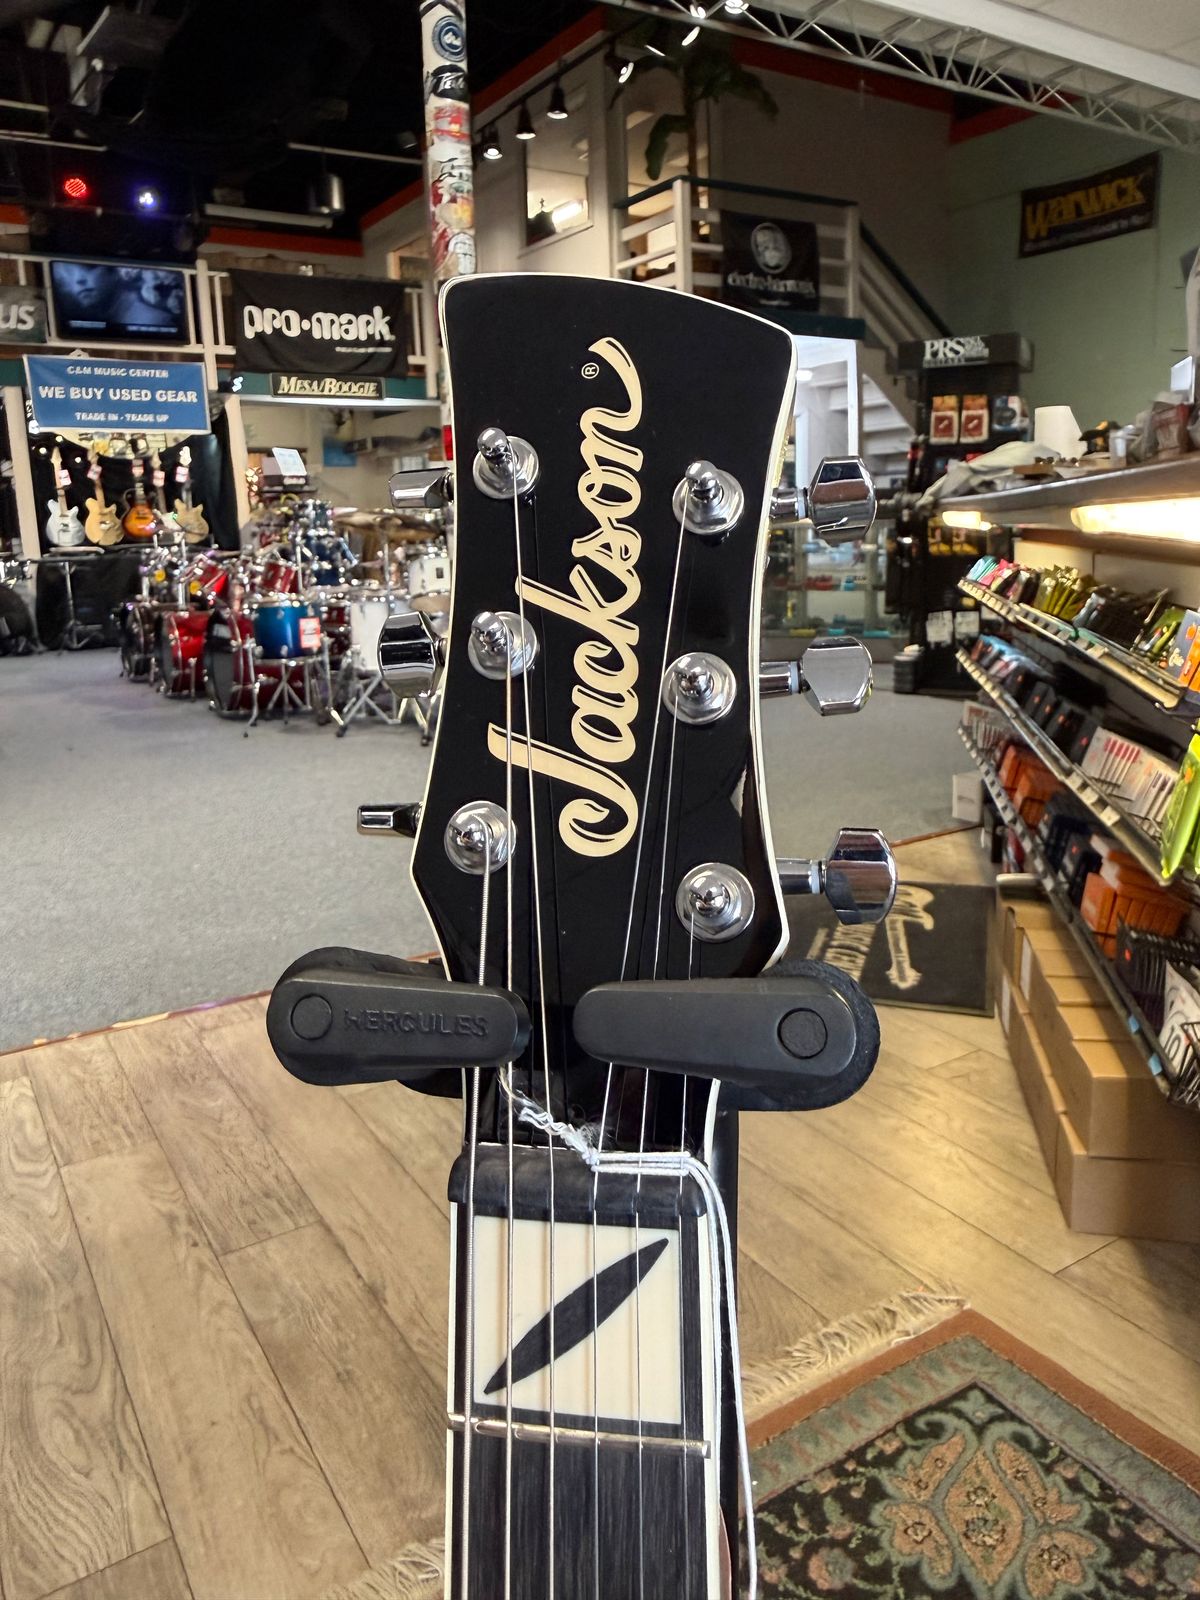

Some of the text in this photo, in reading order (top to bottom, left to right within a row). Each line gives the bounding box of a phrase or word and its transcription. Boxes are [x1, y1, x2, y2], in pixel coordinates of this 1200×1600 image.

[924, 337, 965, 359] PRS
[94, 367, 127, 376] MUSIC
[129, 368, 169, 378] CENTER
[38, 385, 198, 403] WE BUY USED GEAR
[277, 376, 379, 395] MESA/BOOGIE
[75, 412, 106, 421] TRADE
[108, 413, 119, 421] IN
[125, 413, 154, 422] TRADE
[156, 414, 169, 423] UP
[487, 336, 643, 857] Jackson
[343, 1007, 489, 1037] HERCULES
